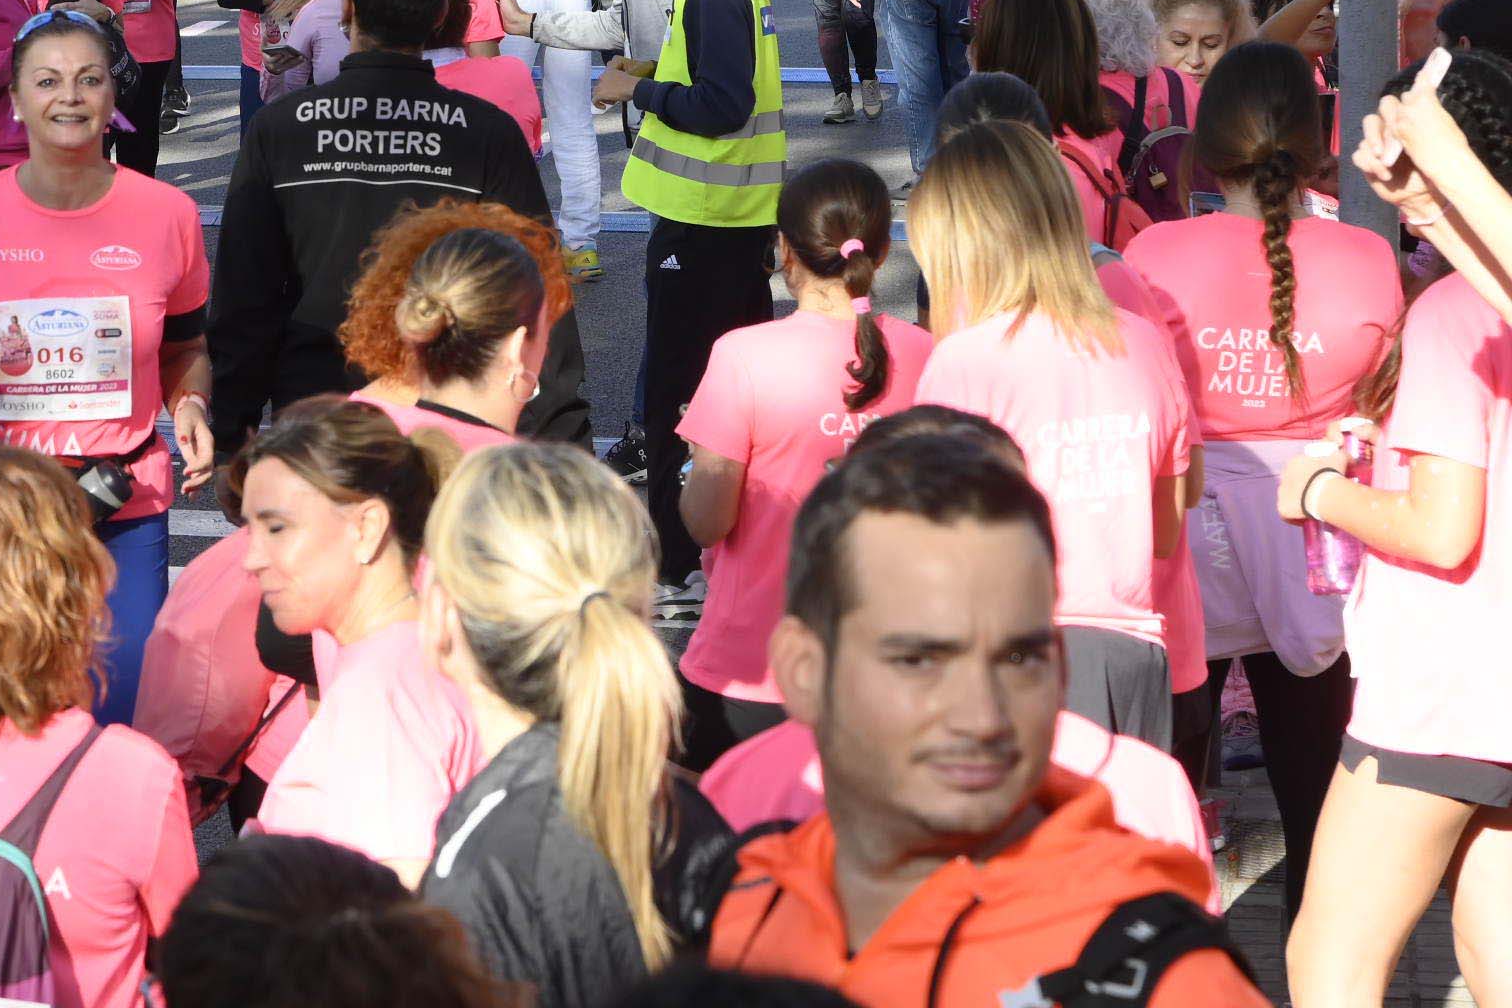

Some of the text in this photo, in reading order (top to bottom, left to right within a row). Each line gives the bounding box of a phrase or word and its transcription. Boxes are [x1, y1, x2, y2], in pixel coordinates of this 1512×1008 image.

[295, 97, 468, 128] GRUP BARNA
[316, 129, 442, 156] PORTERS
[303, 159, 453, 177] www.grupbarnaporters.cat
[93, 253, 138, 266] ASTURIANA
[33, 320, 85, 330] ASTURIANA
[1196, 327, 1325, 355] CARRRA
[37, 347, 84, 364] 016
[1218, 352, 1254, 374] DE
[45, 369, 74, 380] 8602
[6, 385, 44, 393] CARRERA
[45, 385, 56, 393] DE
[57, 384, 70, 392] LA
[70, 383, 98, 392] MUJER
[2, 400, 45, 412] OYSHO
